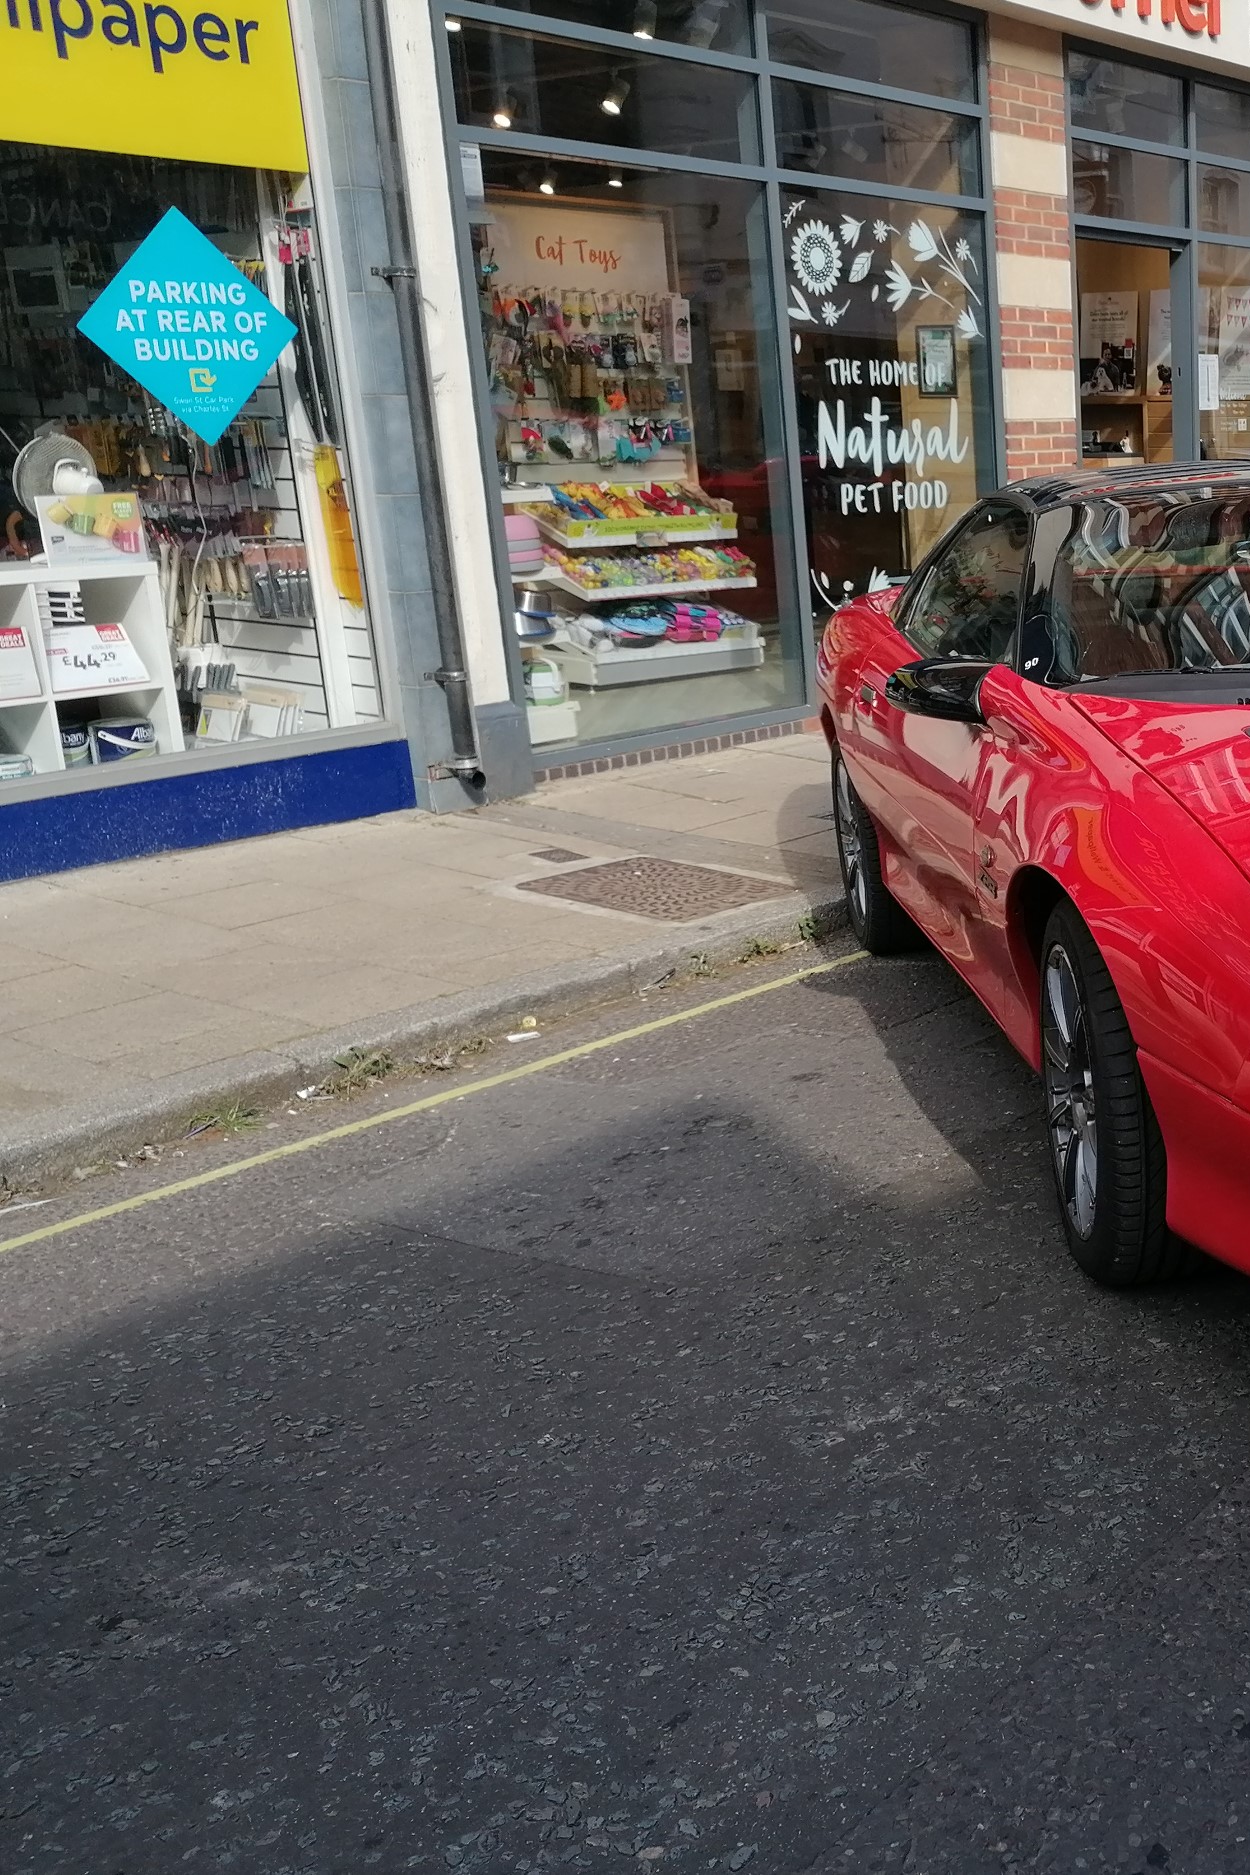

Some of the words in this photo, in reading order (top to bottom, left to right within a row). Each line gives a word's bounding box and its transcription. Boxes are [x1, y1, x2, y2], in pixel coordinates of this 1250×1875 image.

[535, 235, 567, 266] Cat
[572, 239, 622, 273] Toys
[128, 279, 247, 306] PARKING
[116, 309, 148, 332] AT
[156, 309, 228, 333] REAR
[234, 311, 268, 334] OF
[134, 338, 259, 362] BUILDING
[825, 358, 863, 386] THE
[868, 359, 919, 387] HOME
[924, 361, 946, 388] OF
[817, 396, 969, 478] Natural
[840, 481, 884, 516] PET
[892, 479, 948, 514] FOOD
[62, 651, 117, 670] £44.29
[1024, 657, 1039, 670] 90
